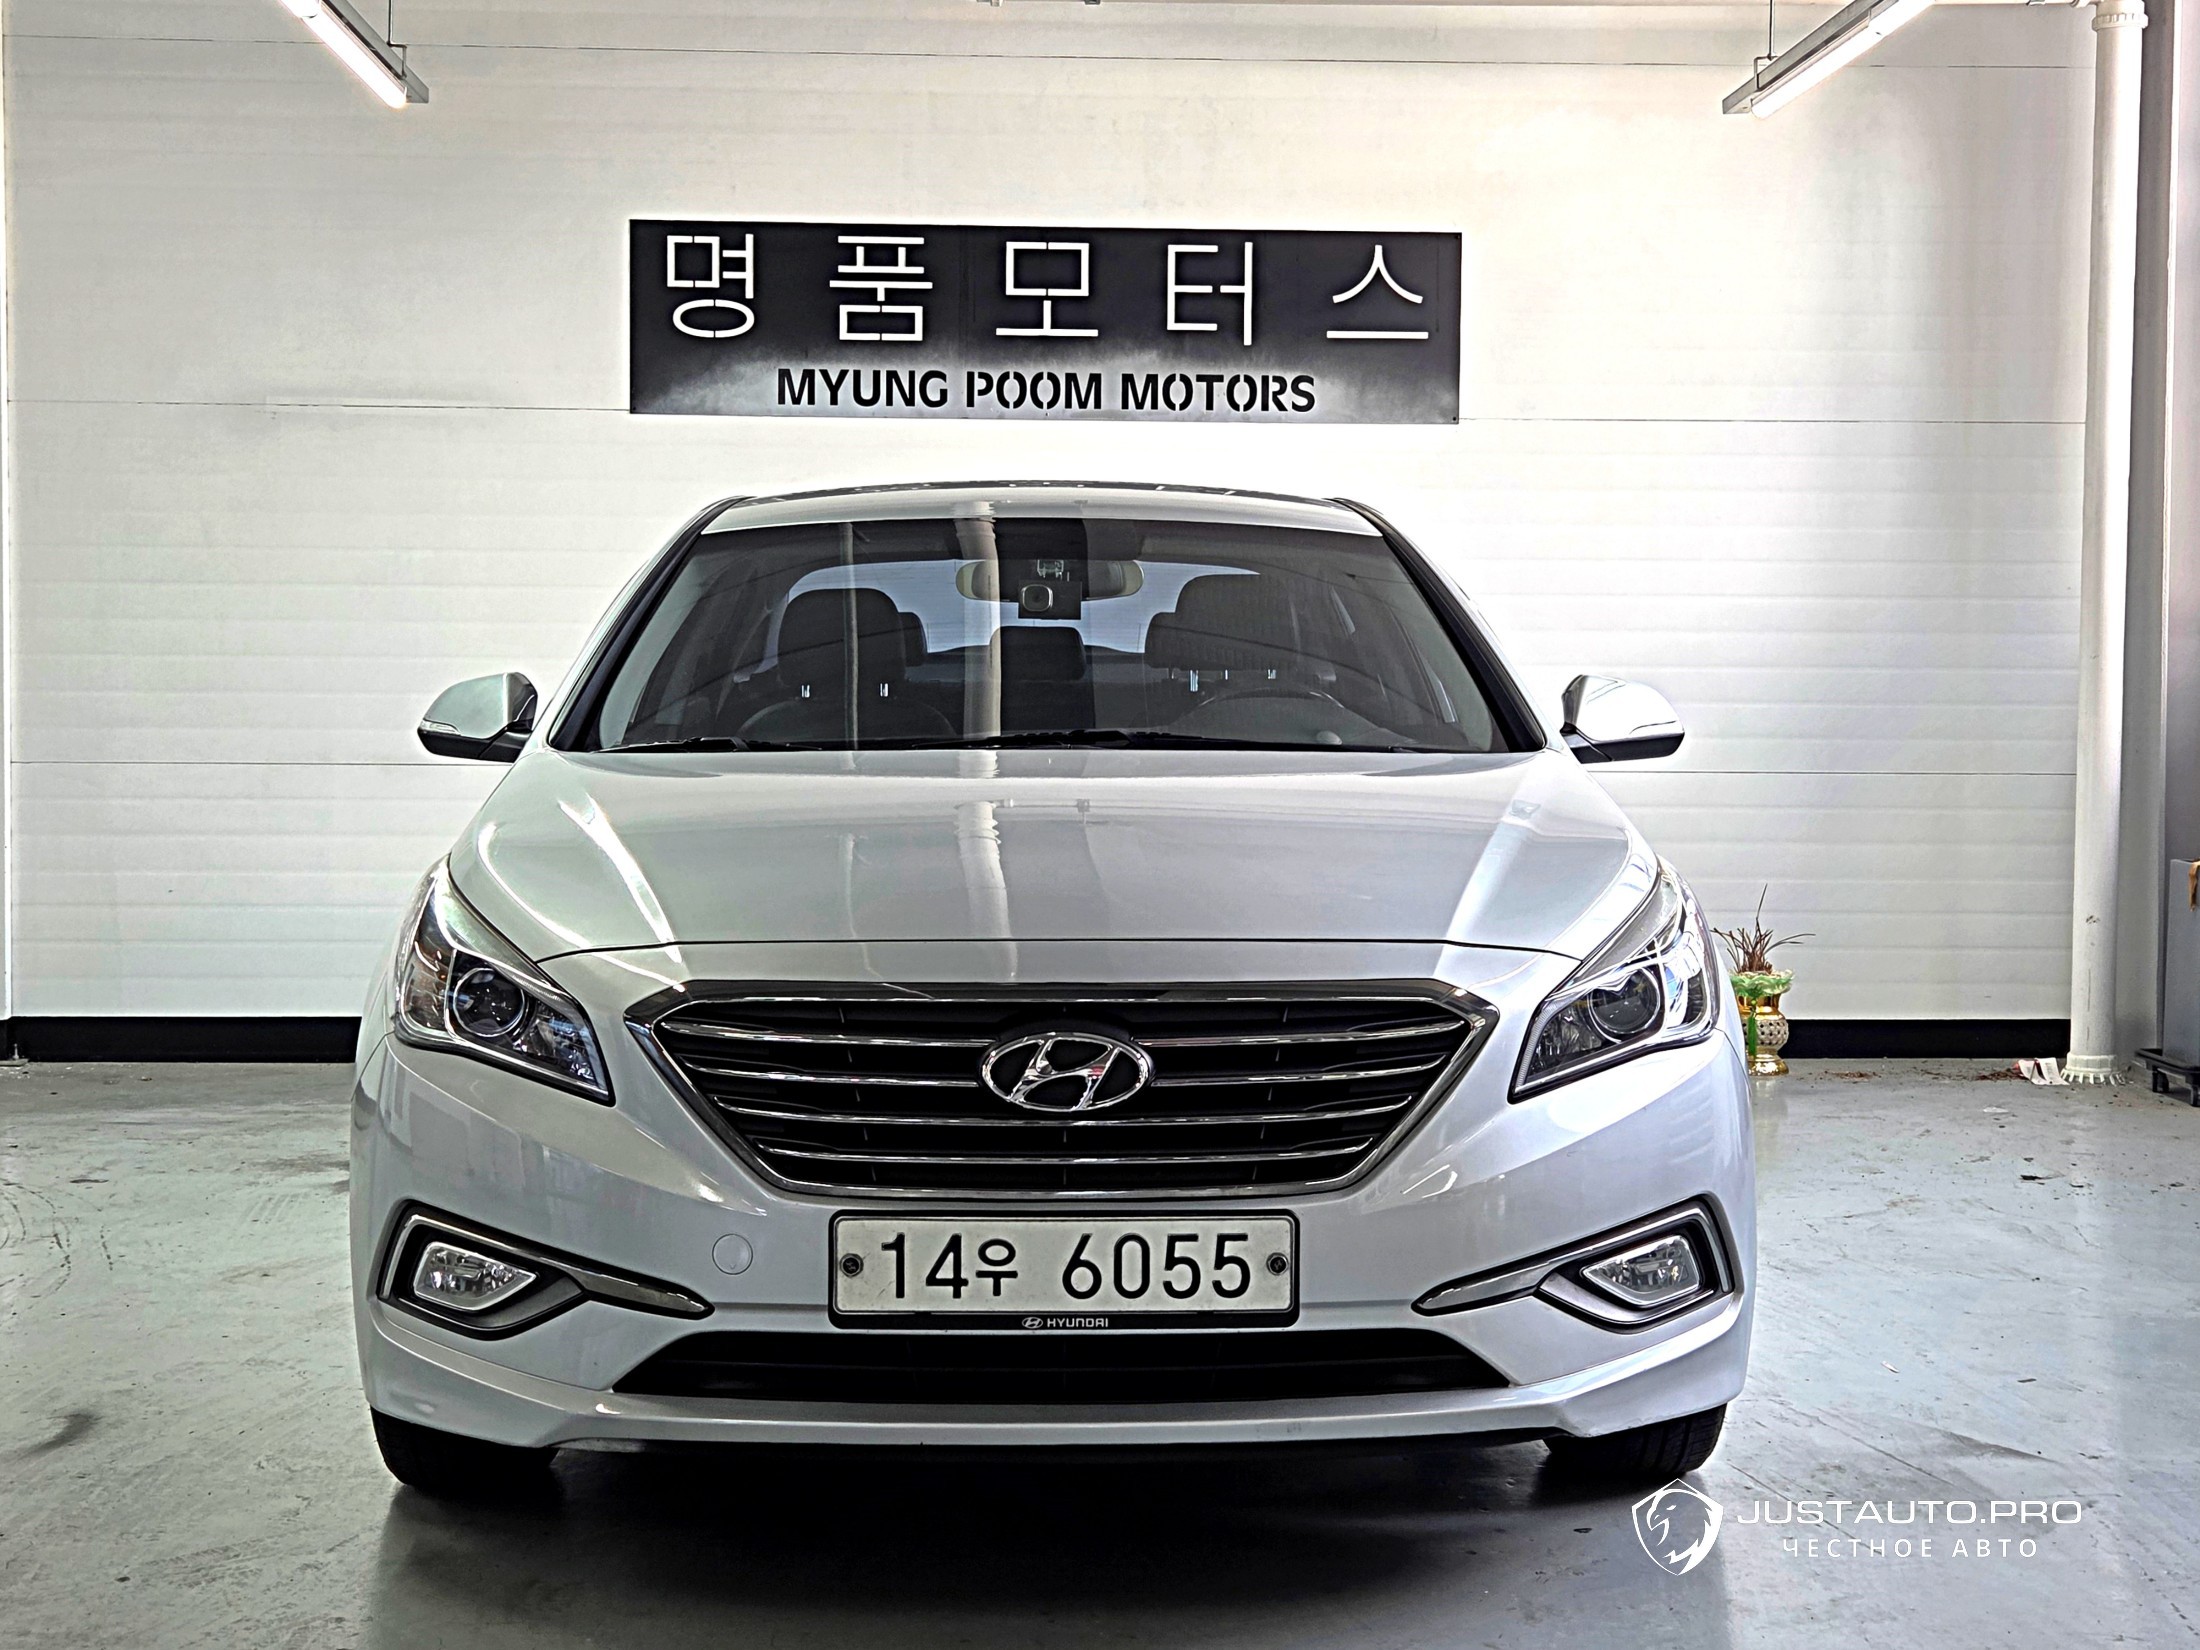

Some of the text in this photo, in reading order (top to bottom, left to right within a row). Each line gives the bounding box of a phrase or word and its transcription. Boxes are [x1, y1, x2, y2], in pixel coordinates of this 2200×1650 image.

[777, 367, 1316, 413] MYUNG POOM MOTORS
[881, 1232, 1251, 1300] 14우 6055
[1046, 1317, 1109, 1329] HYUNDAI
